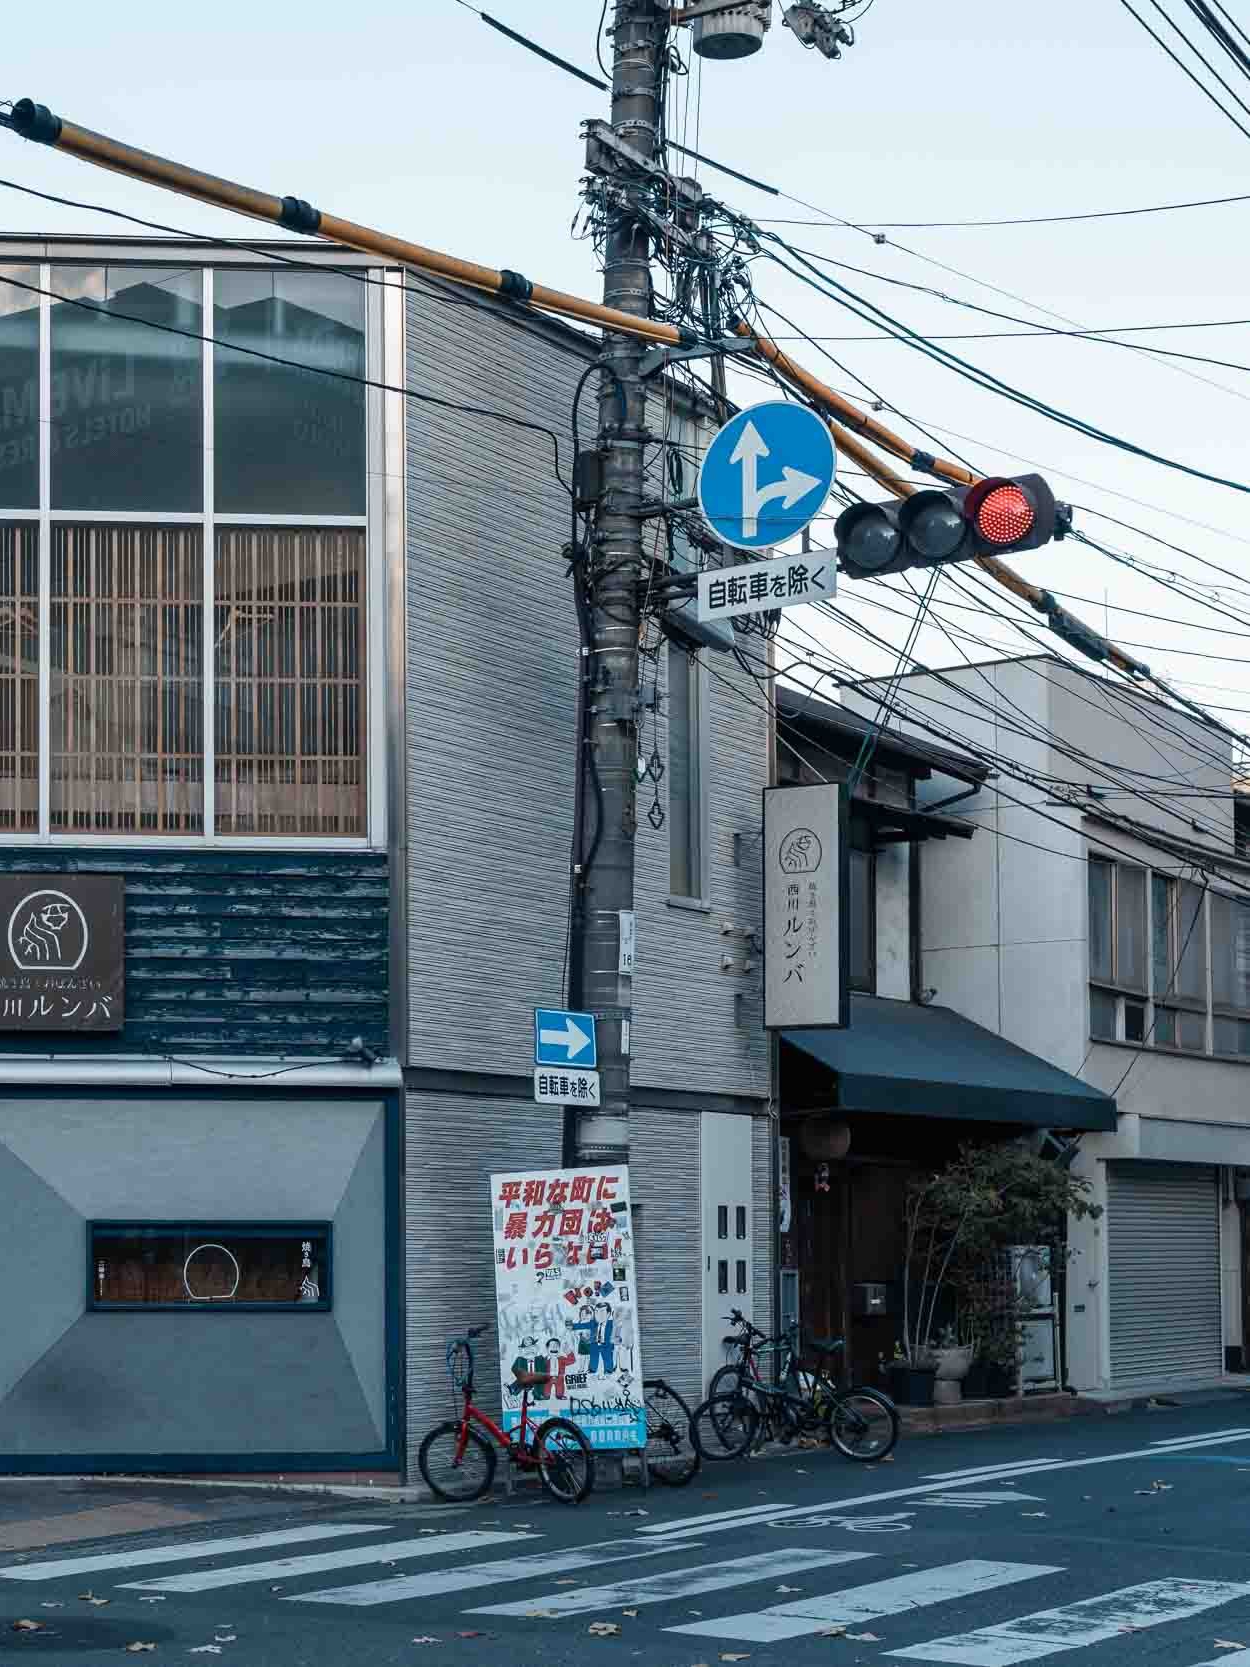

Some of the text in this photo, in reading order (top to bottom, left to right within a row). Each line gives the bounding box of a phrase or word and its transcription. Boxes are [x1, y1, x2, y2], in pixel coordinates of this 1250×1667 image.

[708, 563, 826, 610] 自転車を除く
[783, 884, 805, 984] 西川ルンバ
[538, 1073, 596, 1100] 自転車を除く
[498, 1175, 621, 1209] 平和な町に
[504, 1207, 614, 1240] 暴力団は
